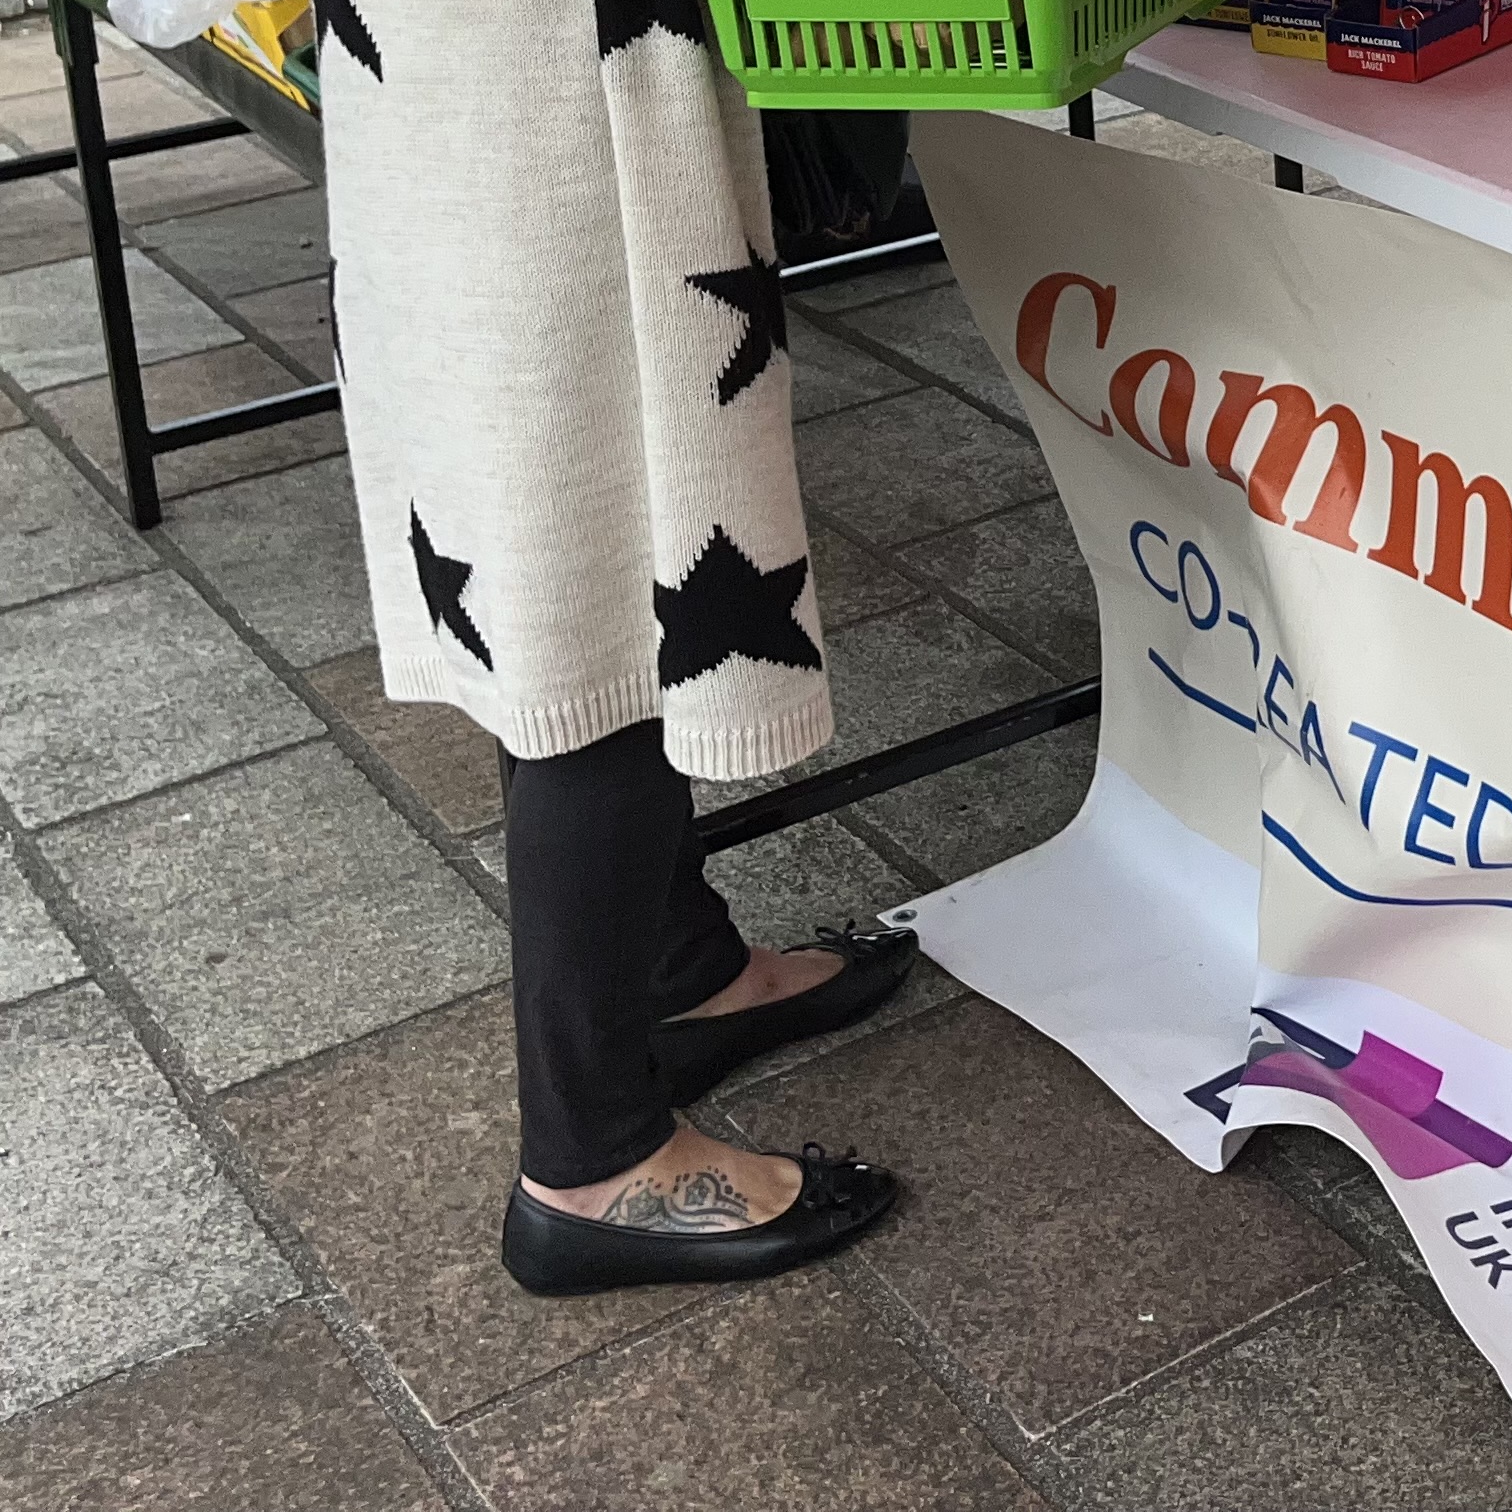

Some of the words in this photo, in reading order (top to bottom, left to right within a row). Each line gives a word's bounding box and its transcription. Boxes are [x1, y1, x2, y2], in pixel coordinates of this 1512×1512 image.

[1263, 14, 1281, 23] JACK
[1281, 16, 1322, 28] MACKEREL
[1340, 33, 1360, 43] JACK
[1361, 36, 1402, 48] MACKEREL
[1348, 49, 1364, 59] RICH
[1366, 51, 1396, 64] TOMATO
[1361, 60, 1384, 72] SAUCE
